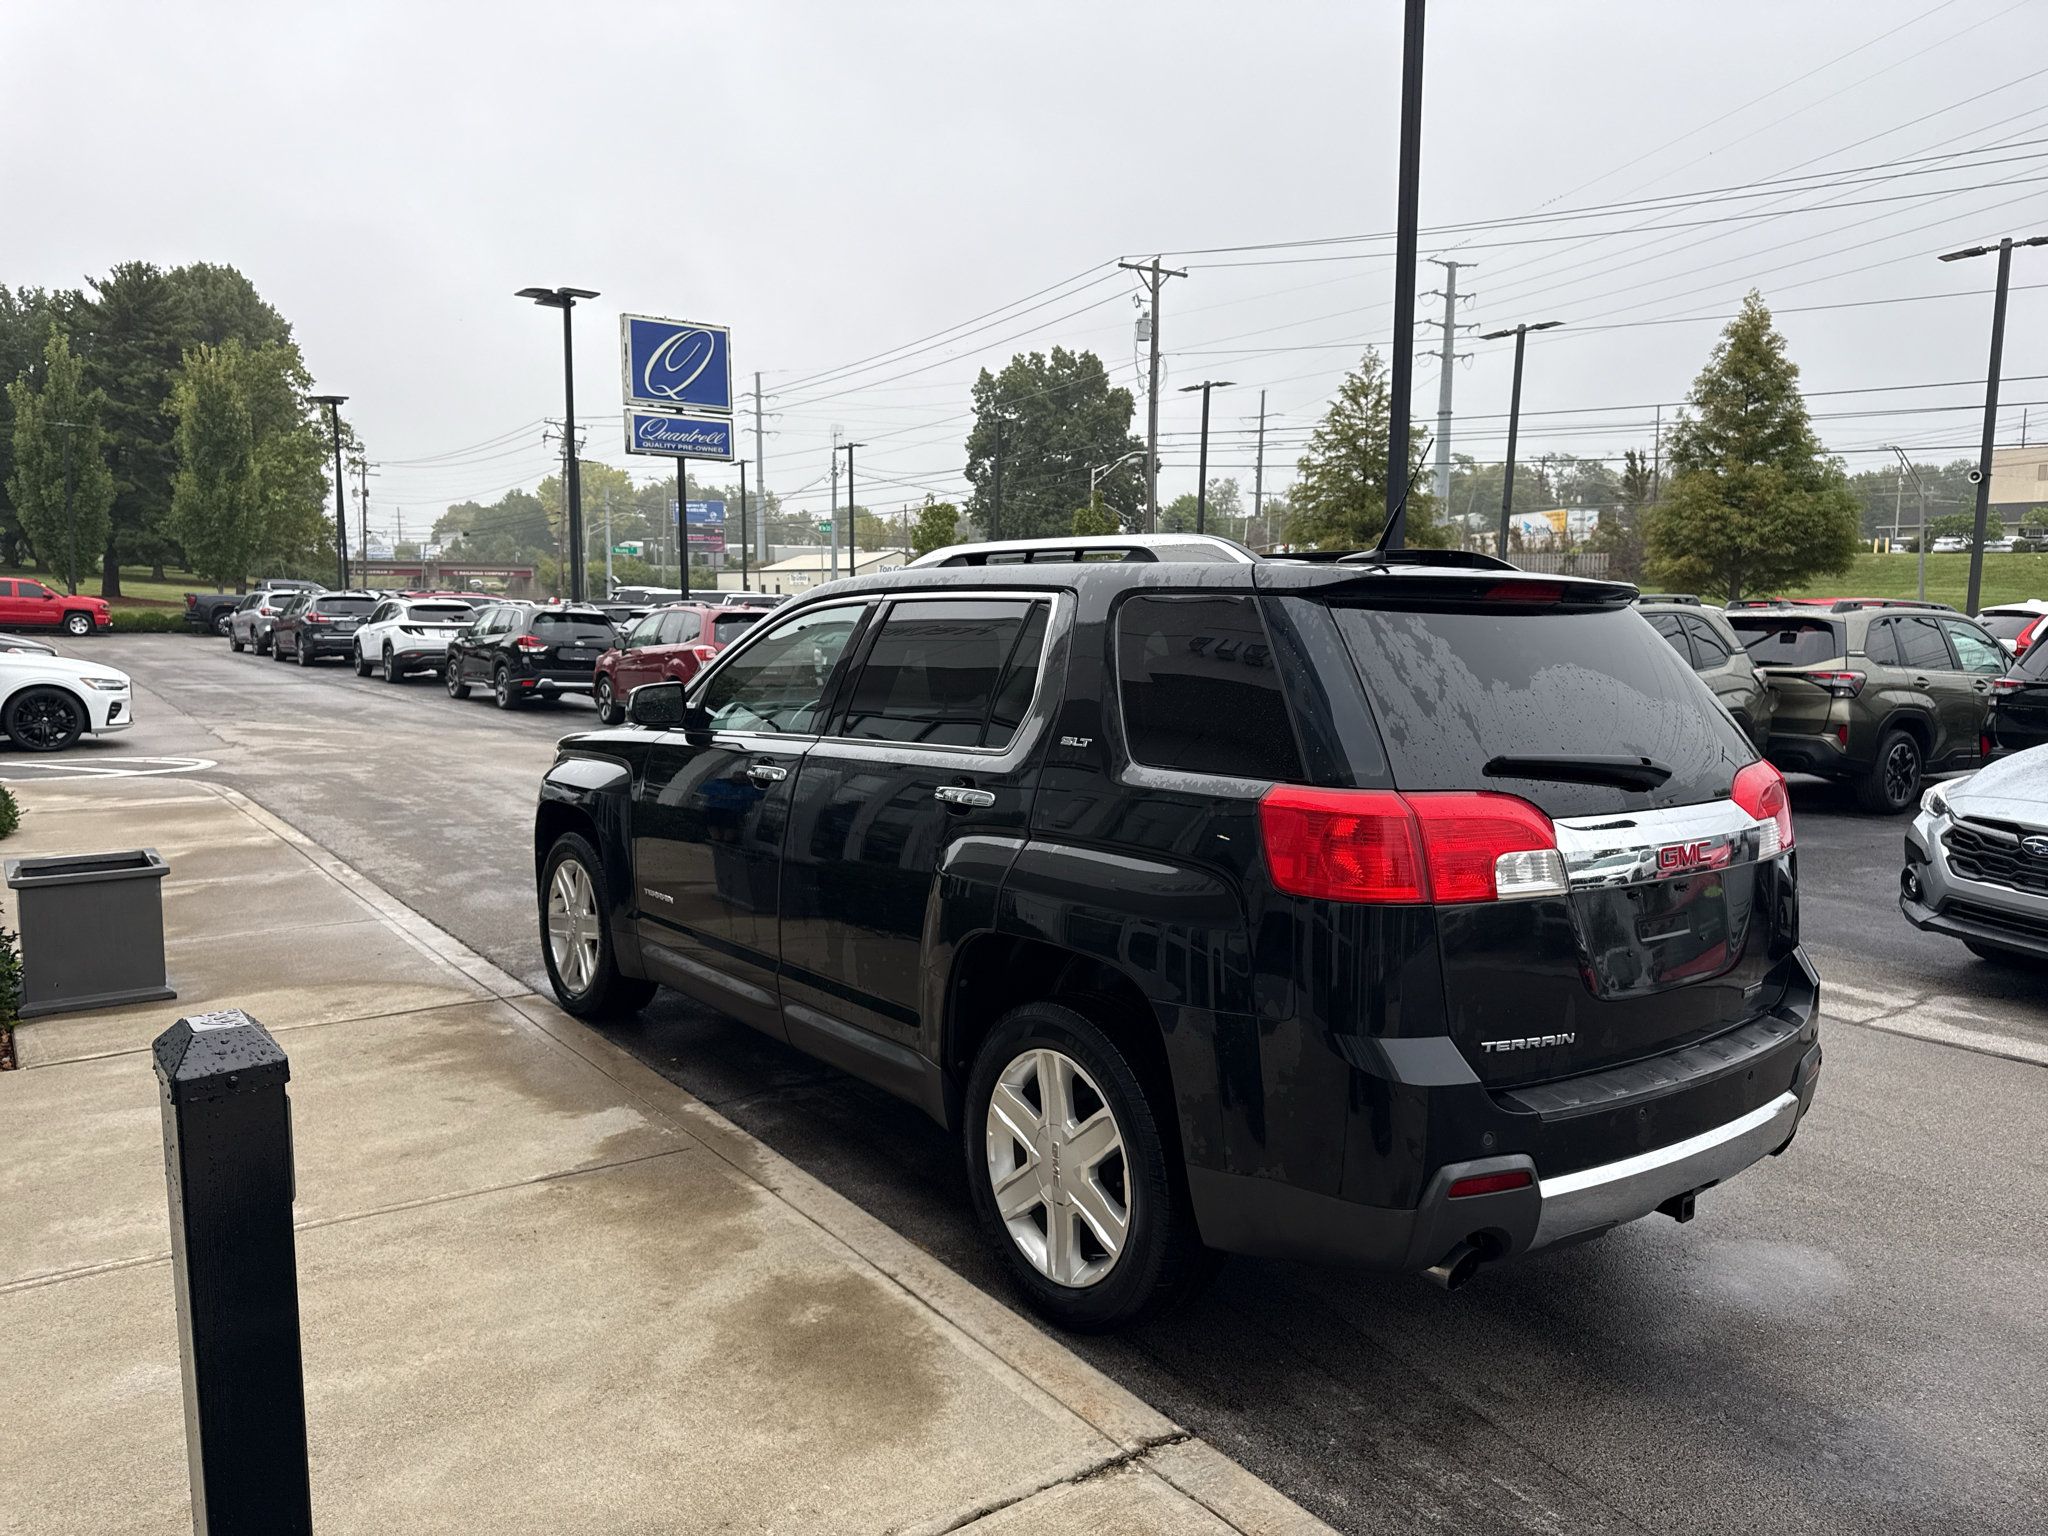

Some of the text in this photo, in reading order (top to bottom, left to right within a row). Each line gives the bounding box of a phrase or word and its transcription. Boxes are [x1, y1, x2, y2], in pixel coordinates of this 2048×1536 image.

[644, 329, 715, 400] Q
[639, 417, 726, 444] Quantrell
[642, 441, 724, 453] QUALITY PRE-OWNED
[1060, 736, 1093, 748] SLT
[1656, 840, 1714, 869] GMC
[1481, 1032, 1576, 1053] TERRAIN
